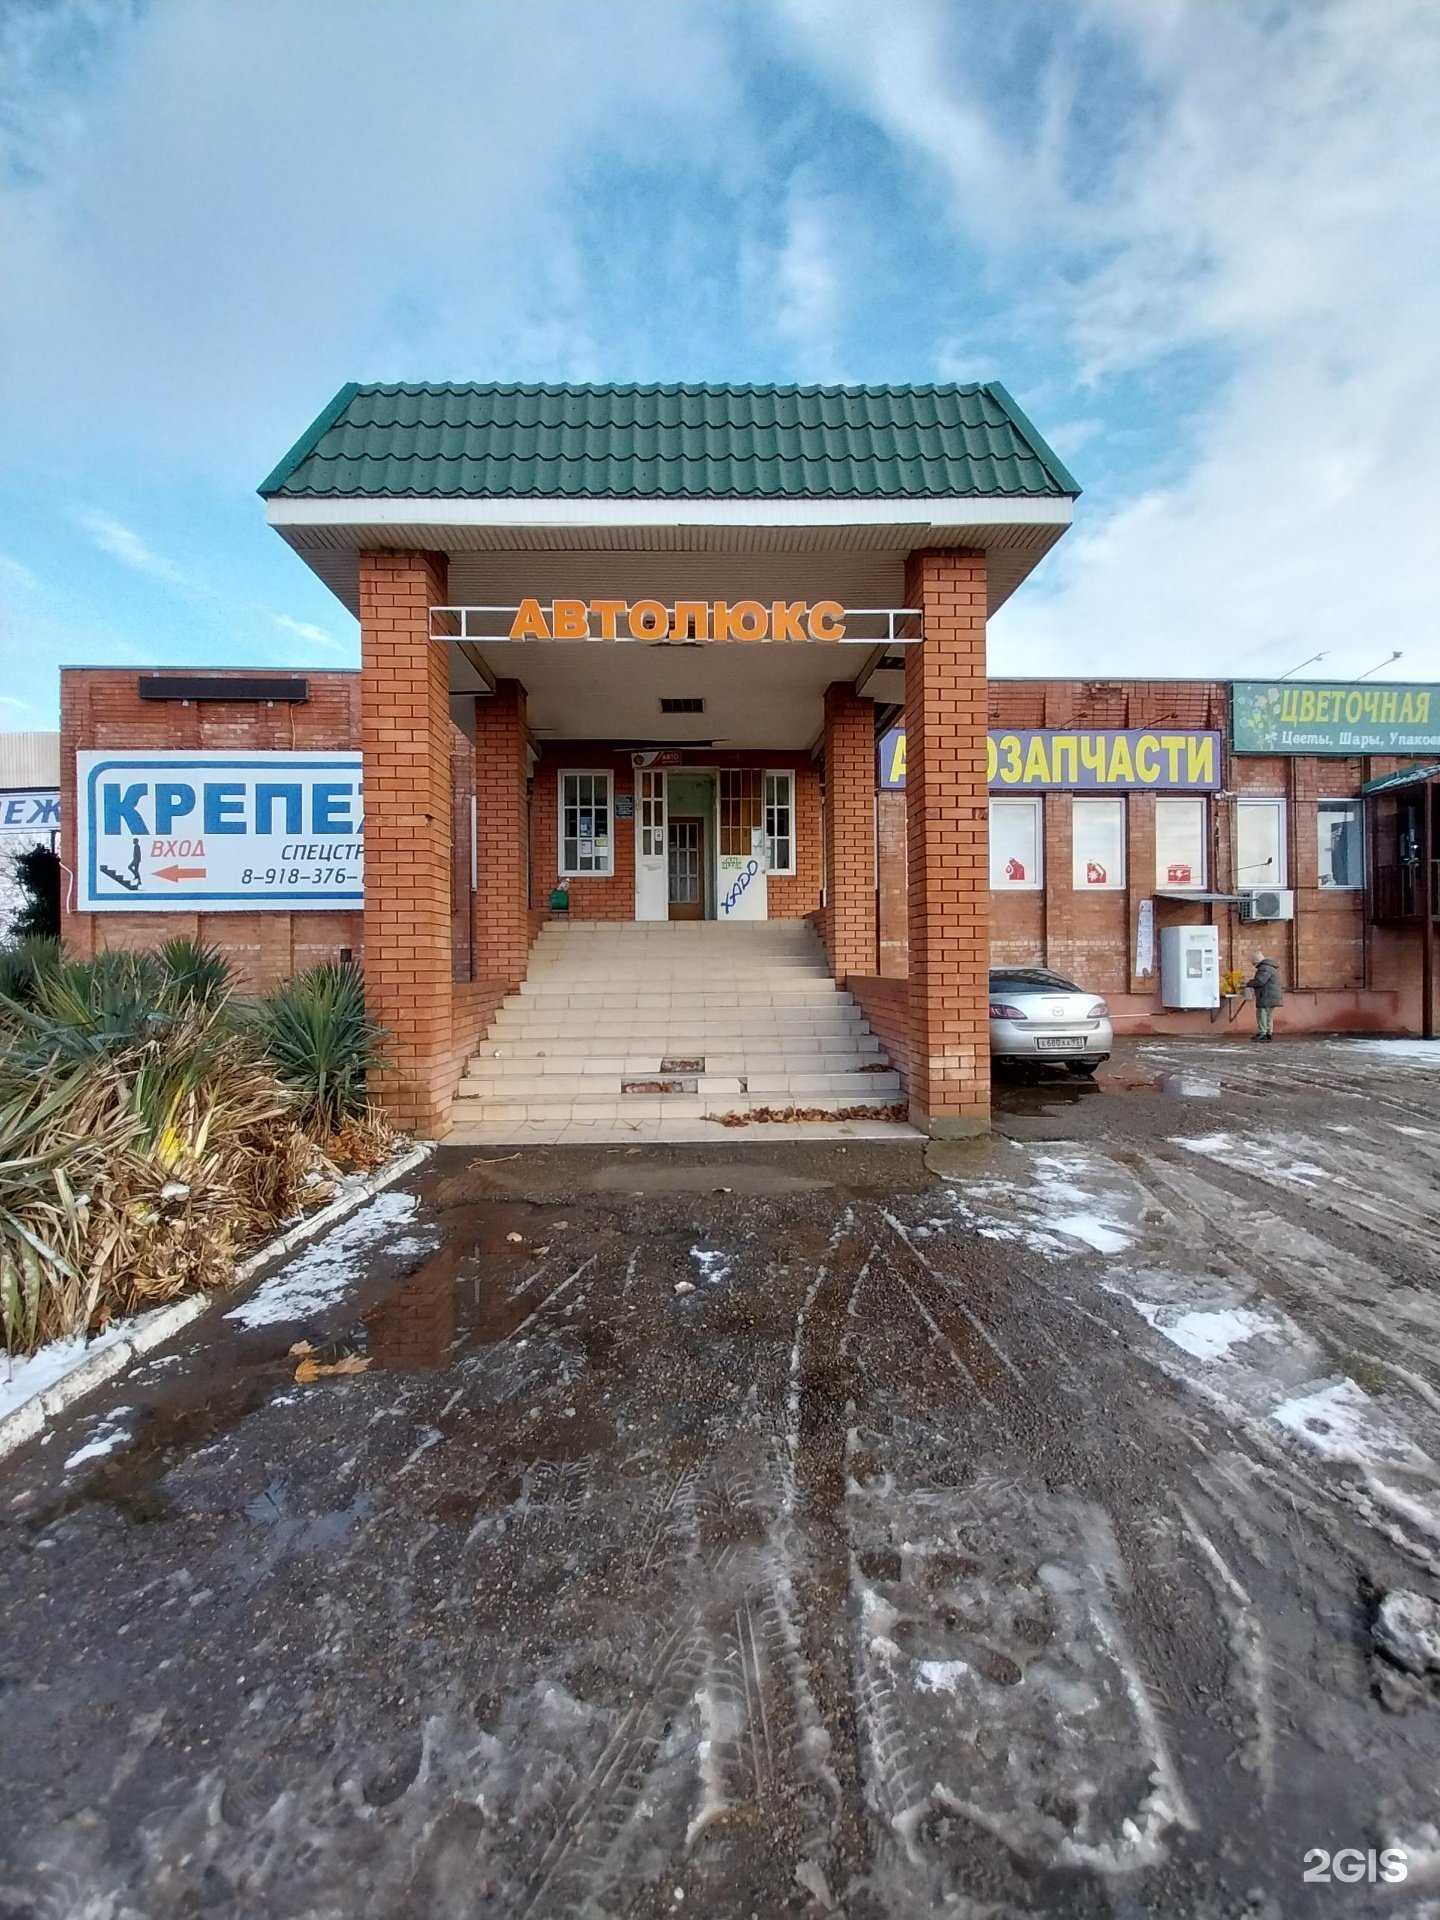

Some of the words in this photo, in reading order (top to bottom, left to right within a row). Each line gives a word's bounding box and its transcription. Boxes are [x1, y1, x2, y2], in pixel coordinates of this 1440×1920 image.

[509, 598, 847, 641] АВТОЛЮКС
[1280, 689, 1431, 727] ЦВЕТОЧНАЯ
[1282, 731, 1333, 747] Цветы,
[1339, 732, 1384, 748] Шары,
[889, 734, 1213, 785] АЗАПЧАСТИ
[0, 799, 60, 824] ЕЖ
[104, 783, 364, 835] КРЕПЕ
[150, 840, 206, 858] ВХОД
[242, 868, 364, 885] 8-918-376-
